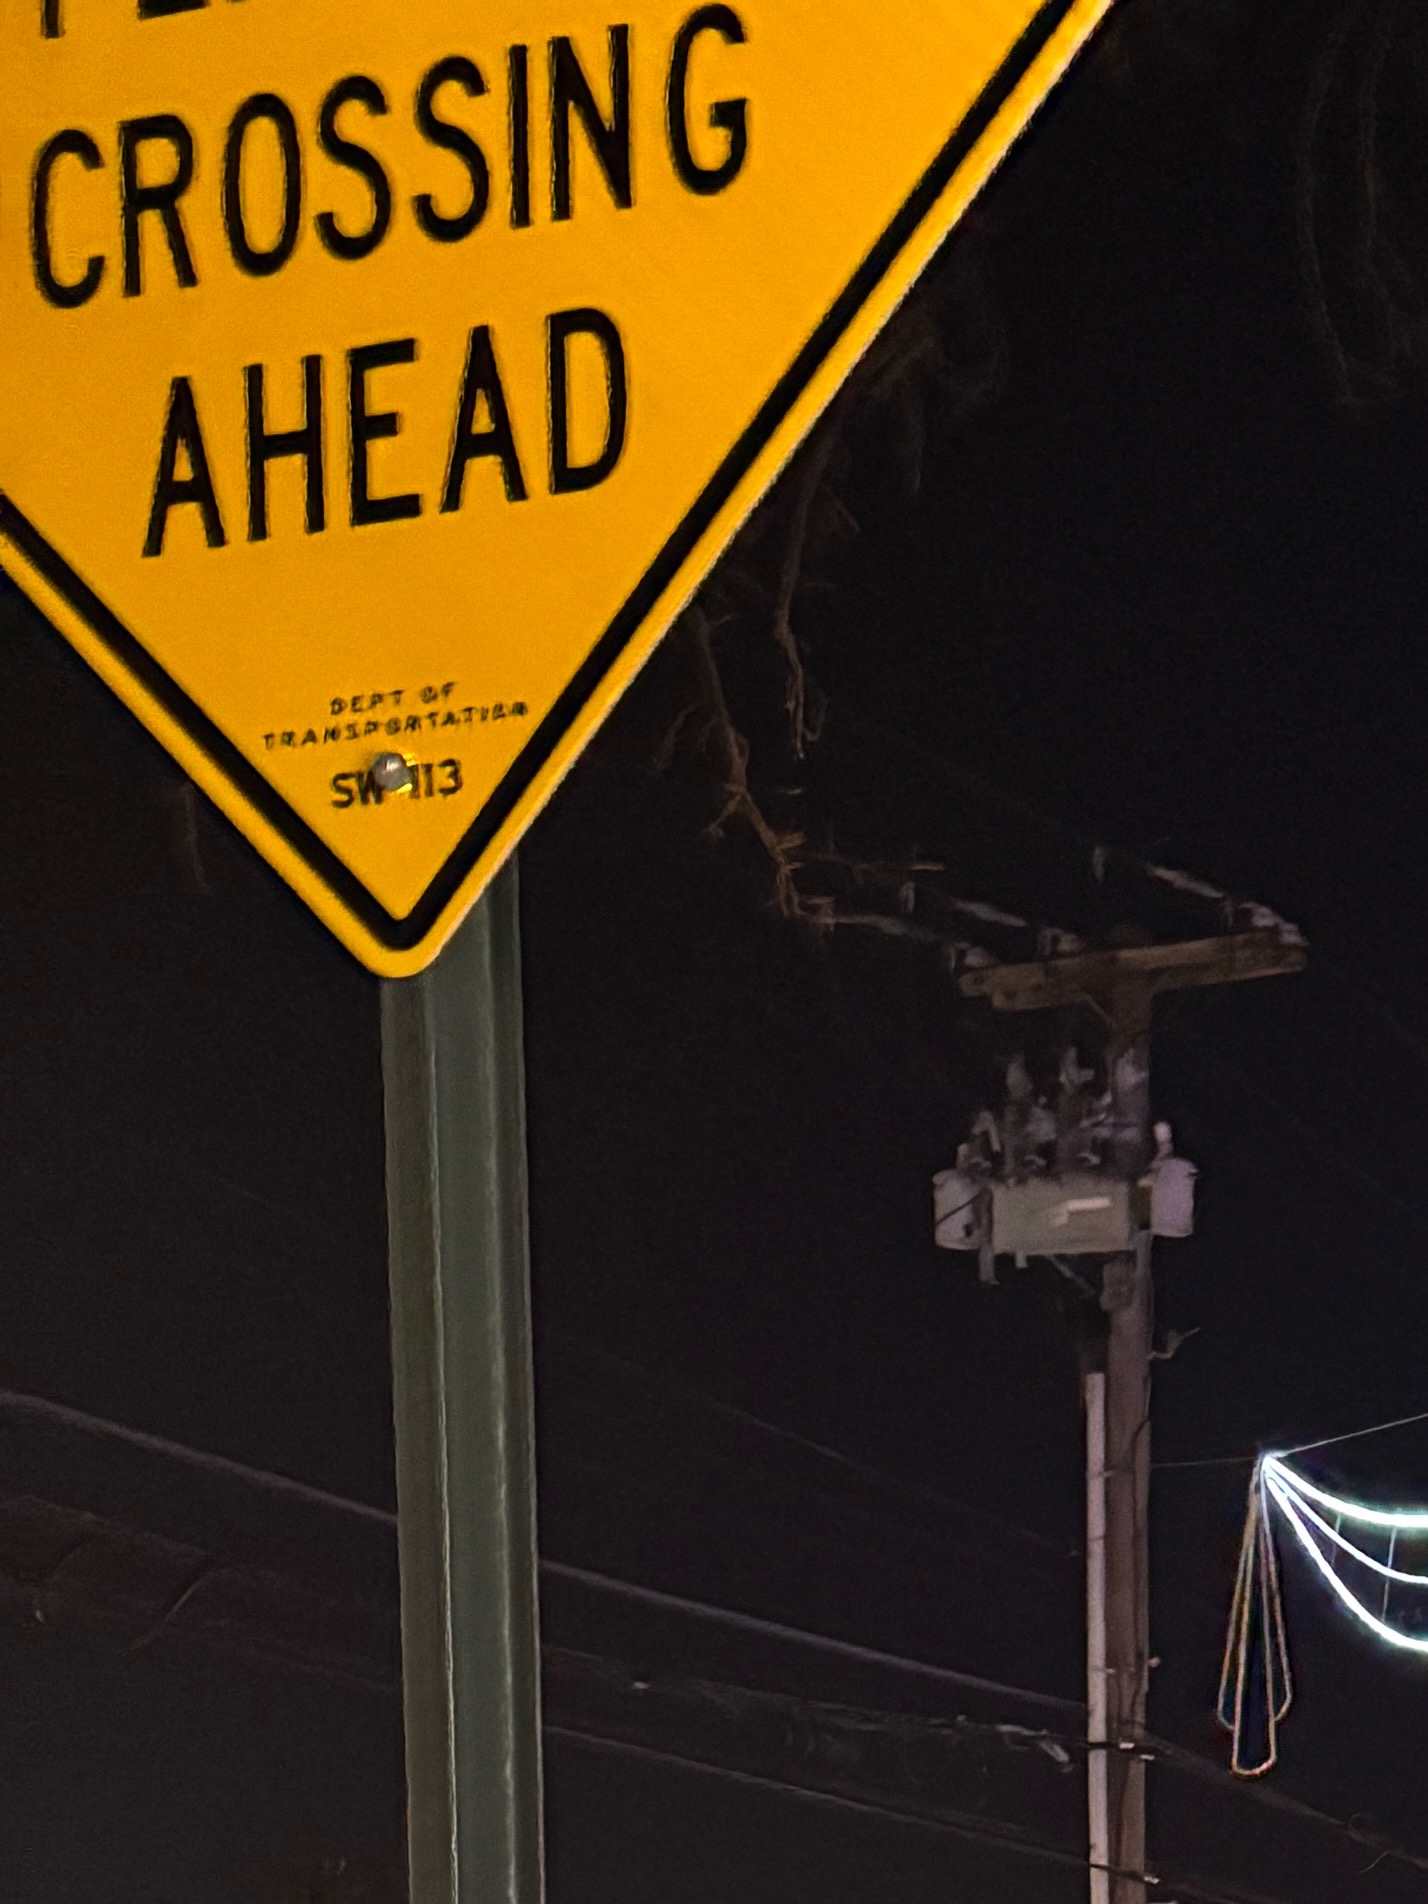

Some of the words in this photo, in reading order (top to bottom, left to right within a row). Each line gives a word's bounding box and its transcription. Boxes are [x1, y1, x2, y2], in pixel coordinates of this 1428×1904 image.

[30, 3, 749, 309] CROSSING
[142, 306, 628, 558] AHEAD
[263, 701, 528, 750] TRANSPORTATION
[420, 682, 455, 704] OF
